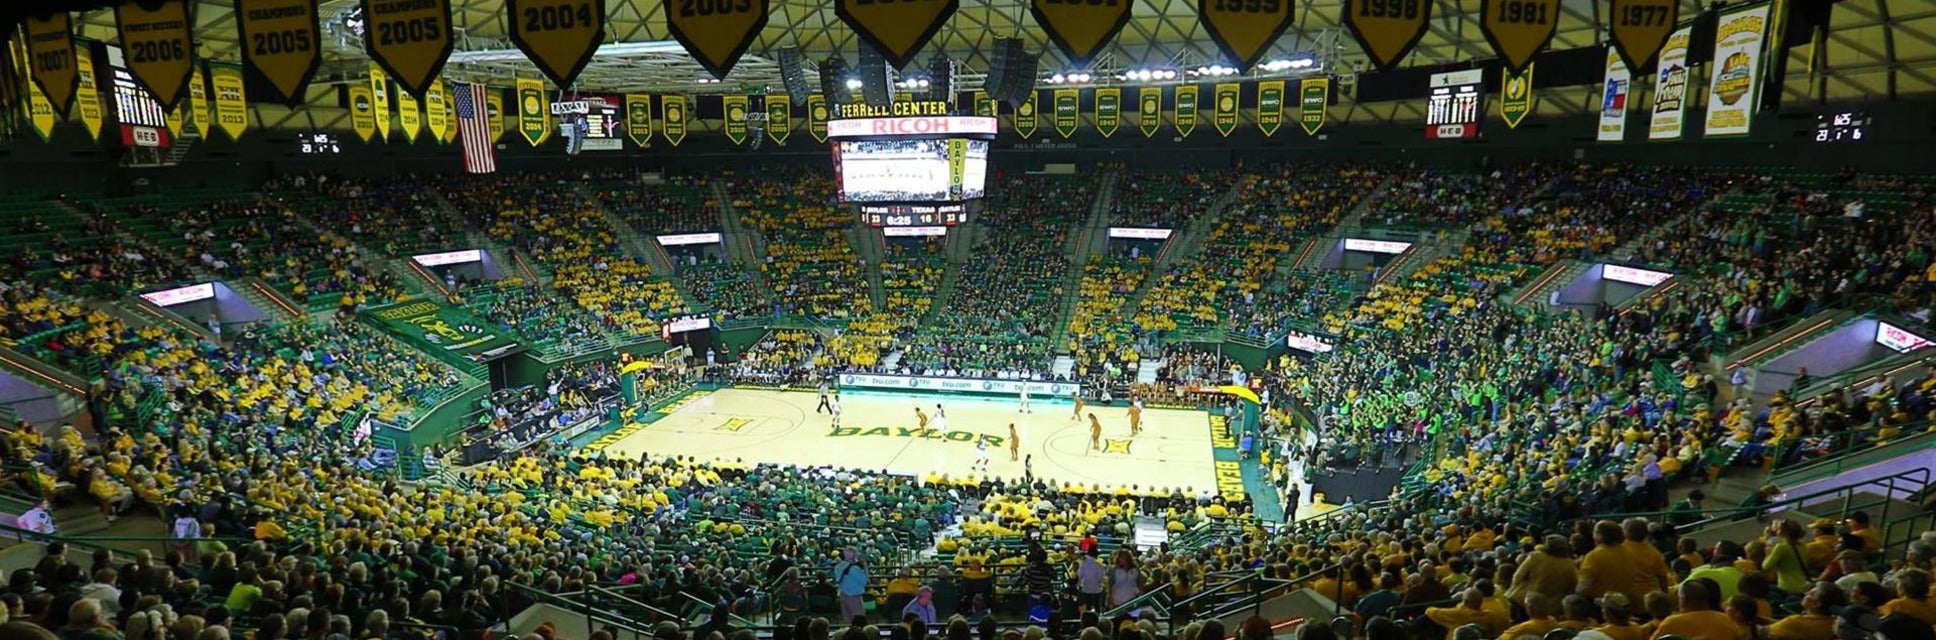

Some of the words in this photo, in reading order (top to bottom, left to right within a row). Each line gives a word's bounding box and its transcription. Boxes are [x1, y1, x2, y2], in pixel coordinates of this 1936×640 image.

[525, 4, 592, 32] 2004
[1499, 1, 1547, 25] 1981
[1619, 4, 1669, 27] 1977
[254, 28, 310, 56] 2005
[378, 16, 440, 46] 2005
[132, 39, 184, 63] 2006
[842, 104, 890, 118] FERRELL
[893, 101, 947, 116] CENTER
[872, 118, 949, 134] RICOH
[871, 377, 901, 386] txu.com
[942, 381, 972, 389] txu.com
[825, 426, 1005, 448] BAYLOR
